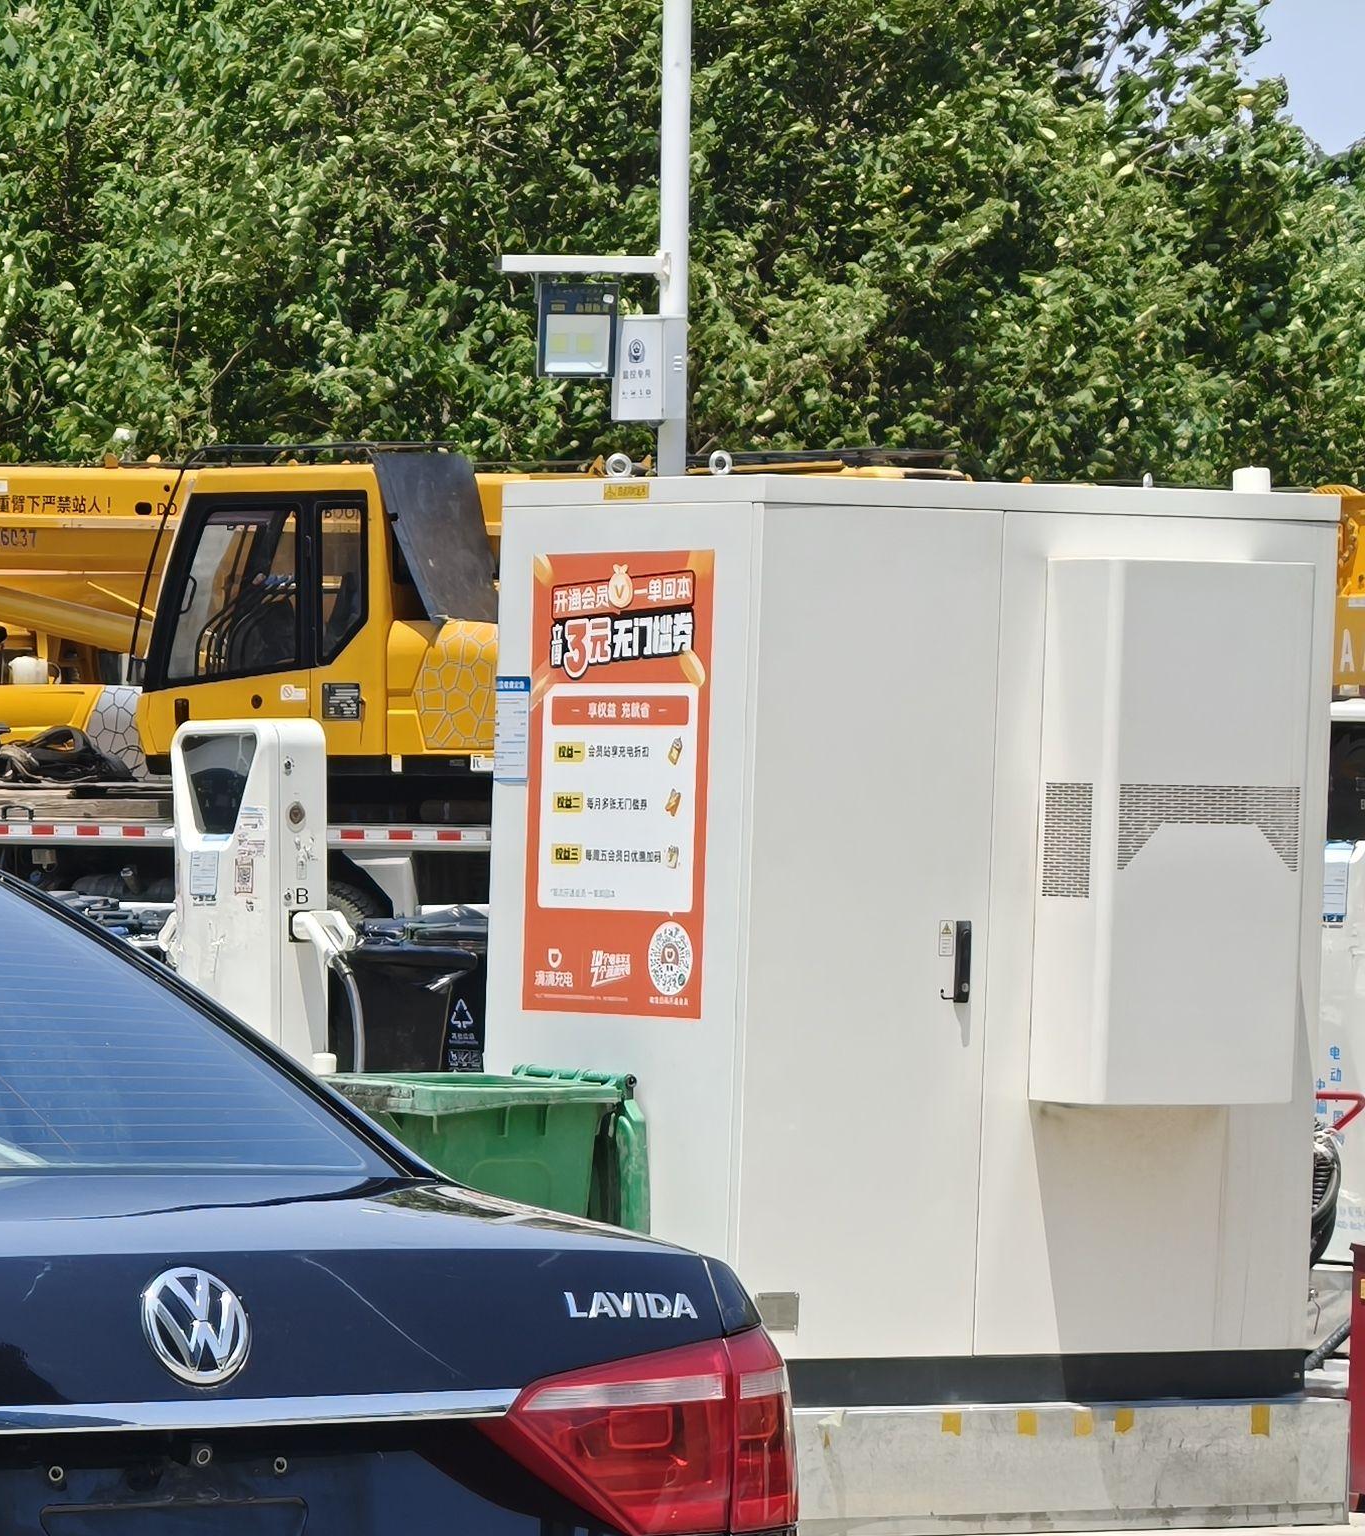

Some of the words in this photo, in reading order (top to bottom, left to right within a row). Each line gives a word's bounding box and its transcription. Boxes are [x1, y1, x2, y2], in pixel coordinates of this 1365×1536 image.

[553, 584, 610, 613] 开通会员
[634, 576, 692, 602] 一单回本
[587, 702, 617, 718] 享权益
[558, 745, 582, 759] 权益一
[557, 796, 581, 809] 权益二
[555, 847, 579, 861] 权益三
[296, 887, 309, 905] B
[563, 1291, 699, 1319] LAVIDA
